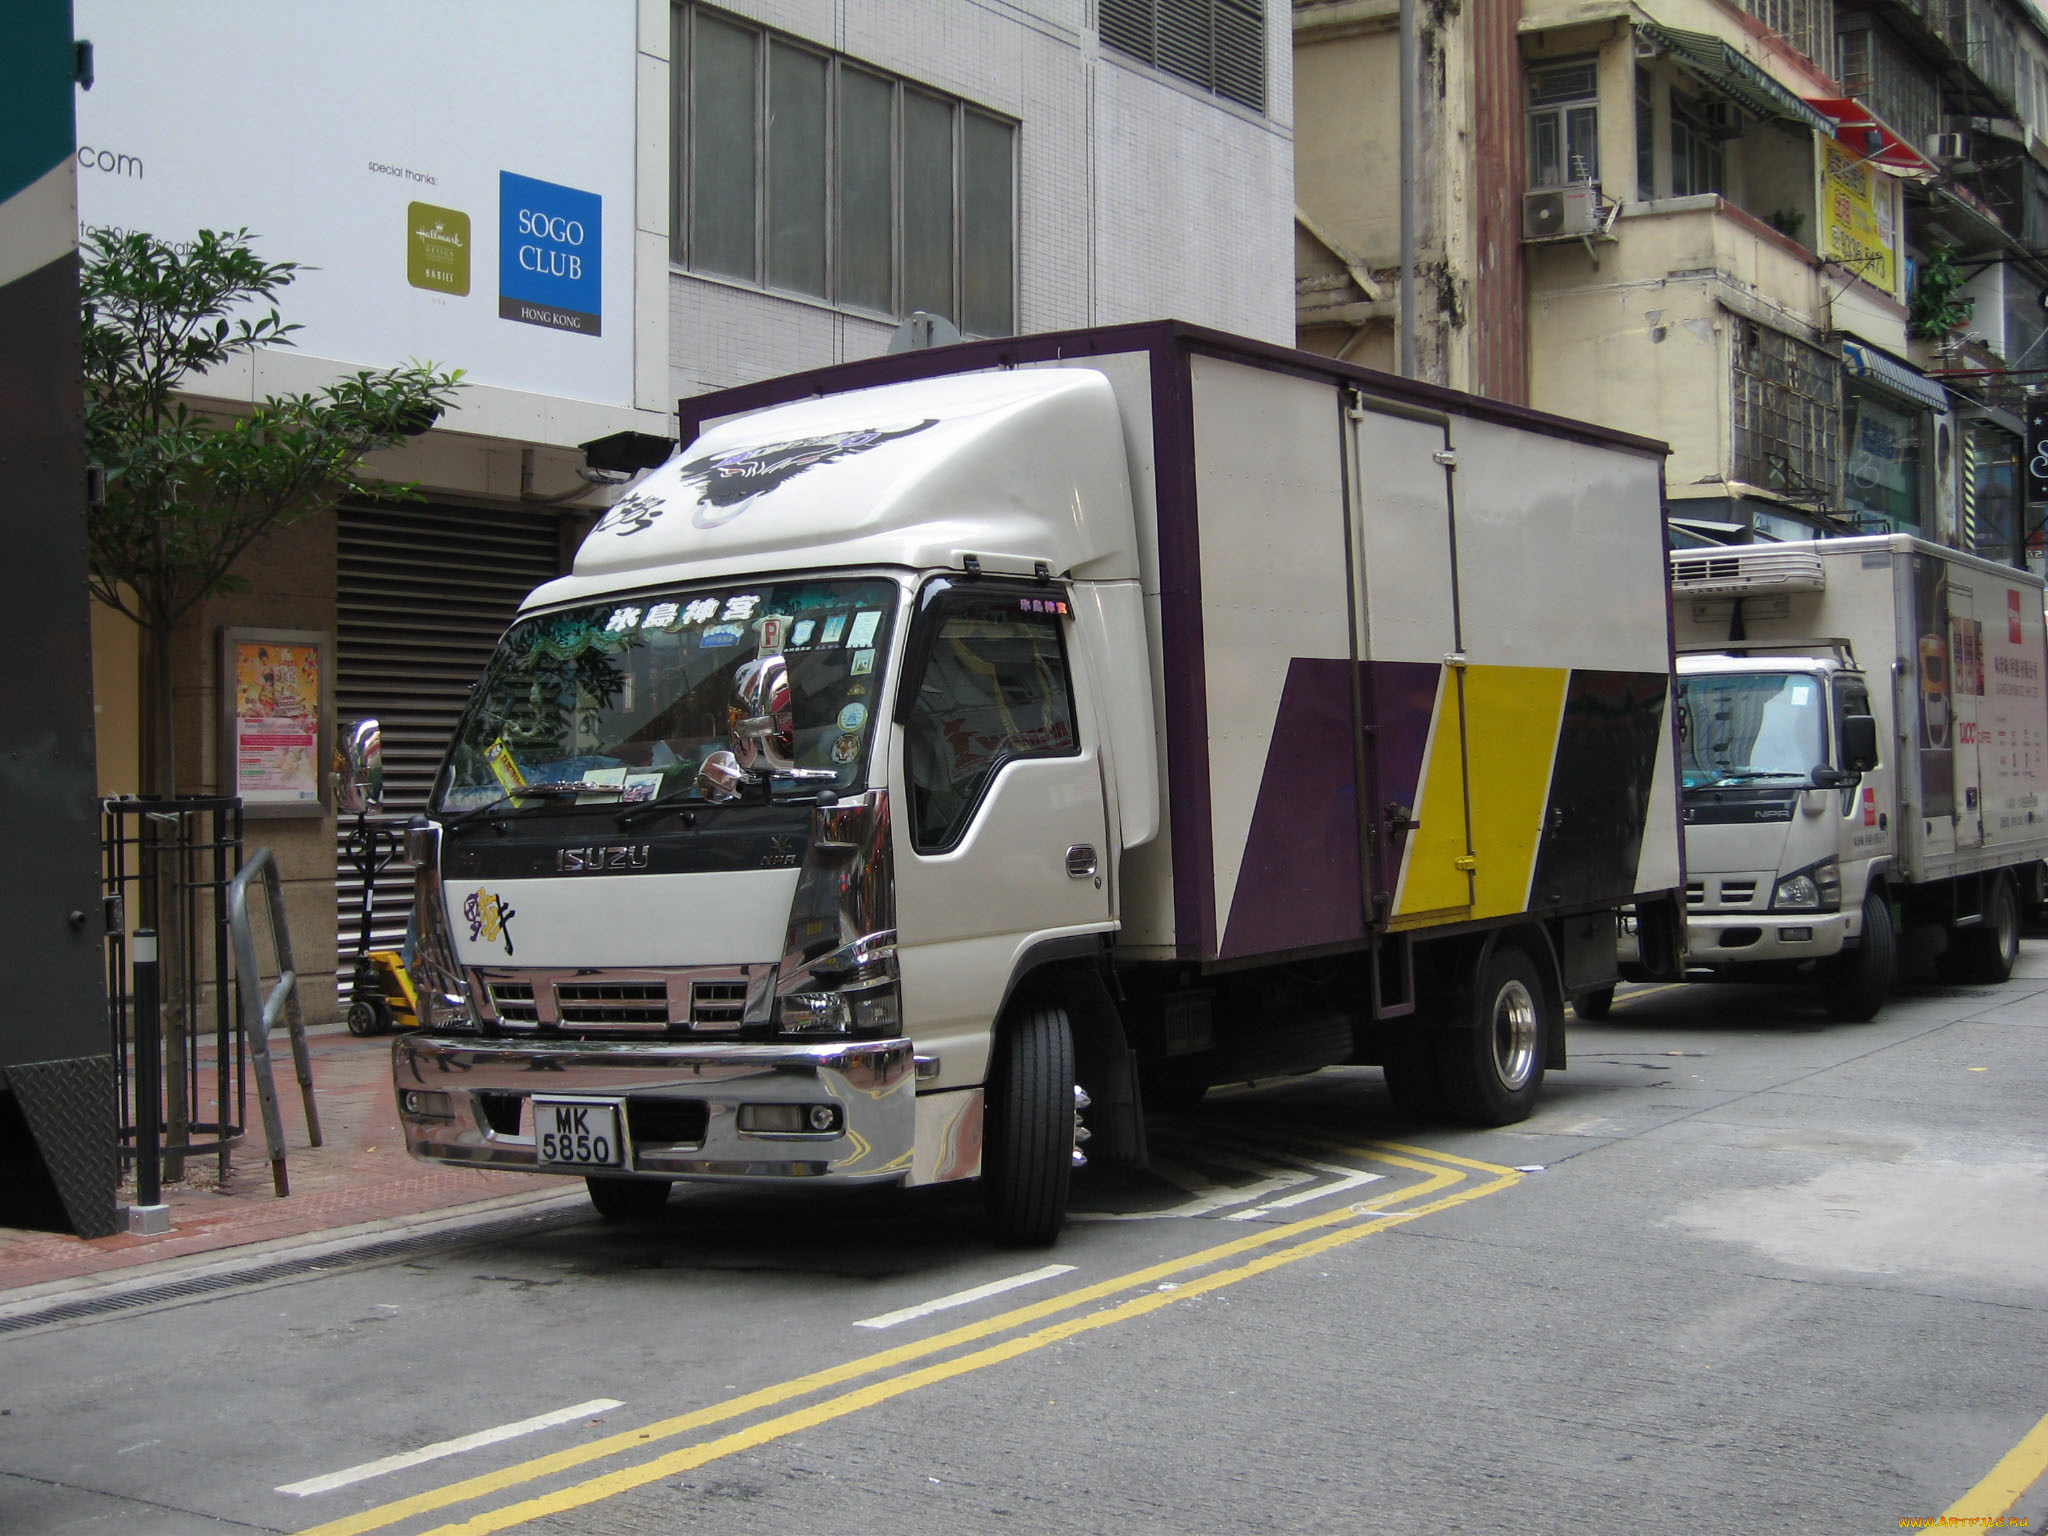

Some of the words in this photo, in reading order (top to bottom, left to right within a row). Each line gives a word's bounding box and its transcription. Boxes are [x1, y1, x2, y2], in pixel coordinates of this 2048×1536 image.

[368, 161, 402, 178] special
[415, 225, 463, 247] Hallmark
[519, 209, 584, 246] SOGO
[519, 245, 582, 280] CLUB
[521, 307, 550, 323] HONG
[553, 313, 581, 329] KONG
[1754, 810, 1790, 819] NPR
[556, 845, 650, 871] ISUZU
[556, 1107, 590, 1135] MK
[543, 1134, 609, 1163] 5850
